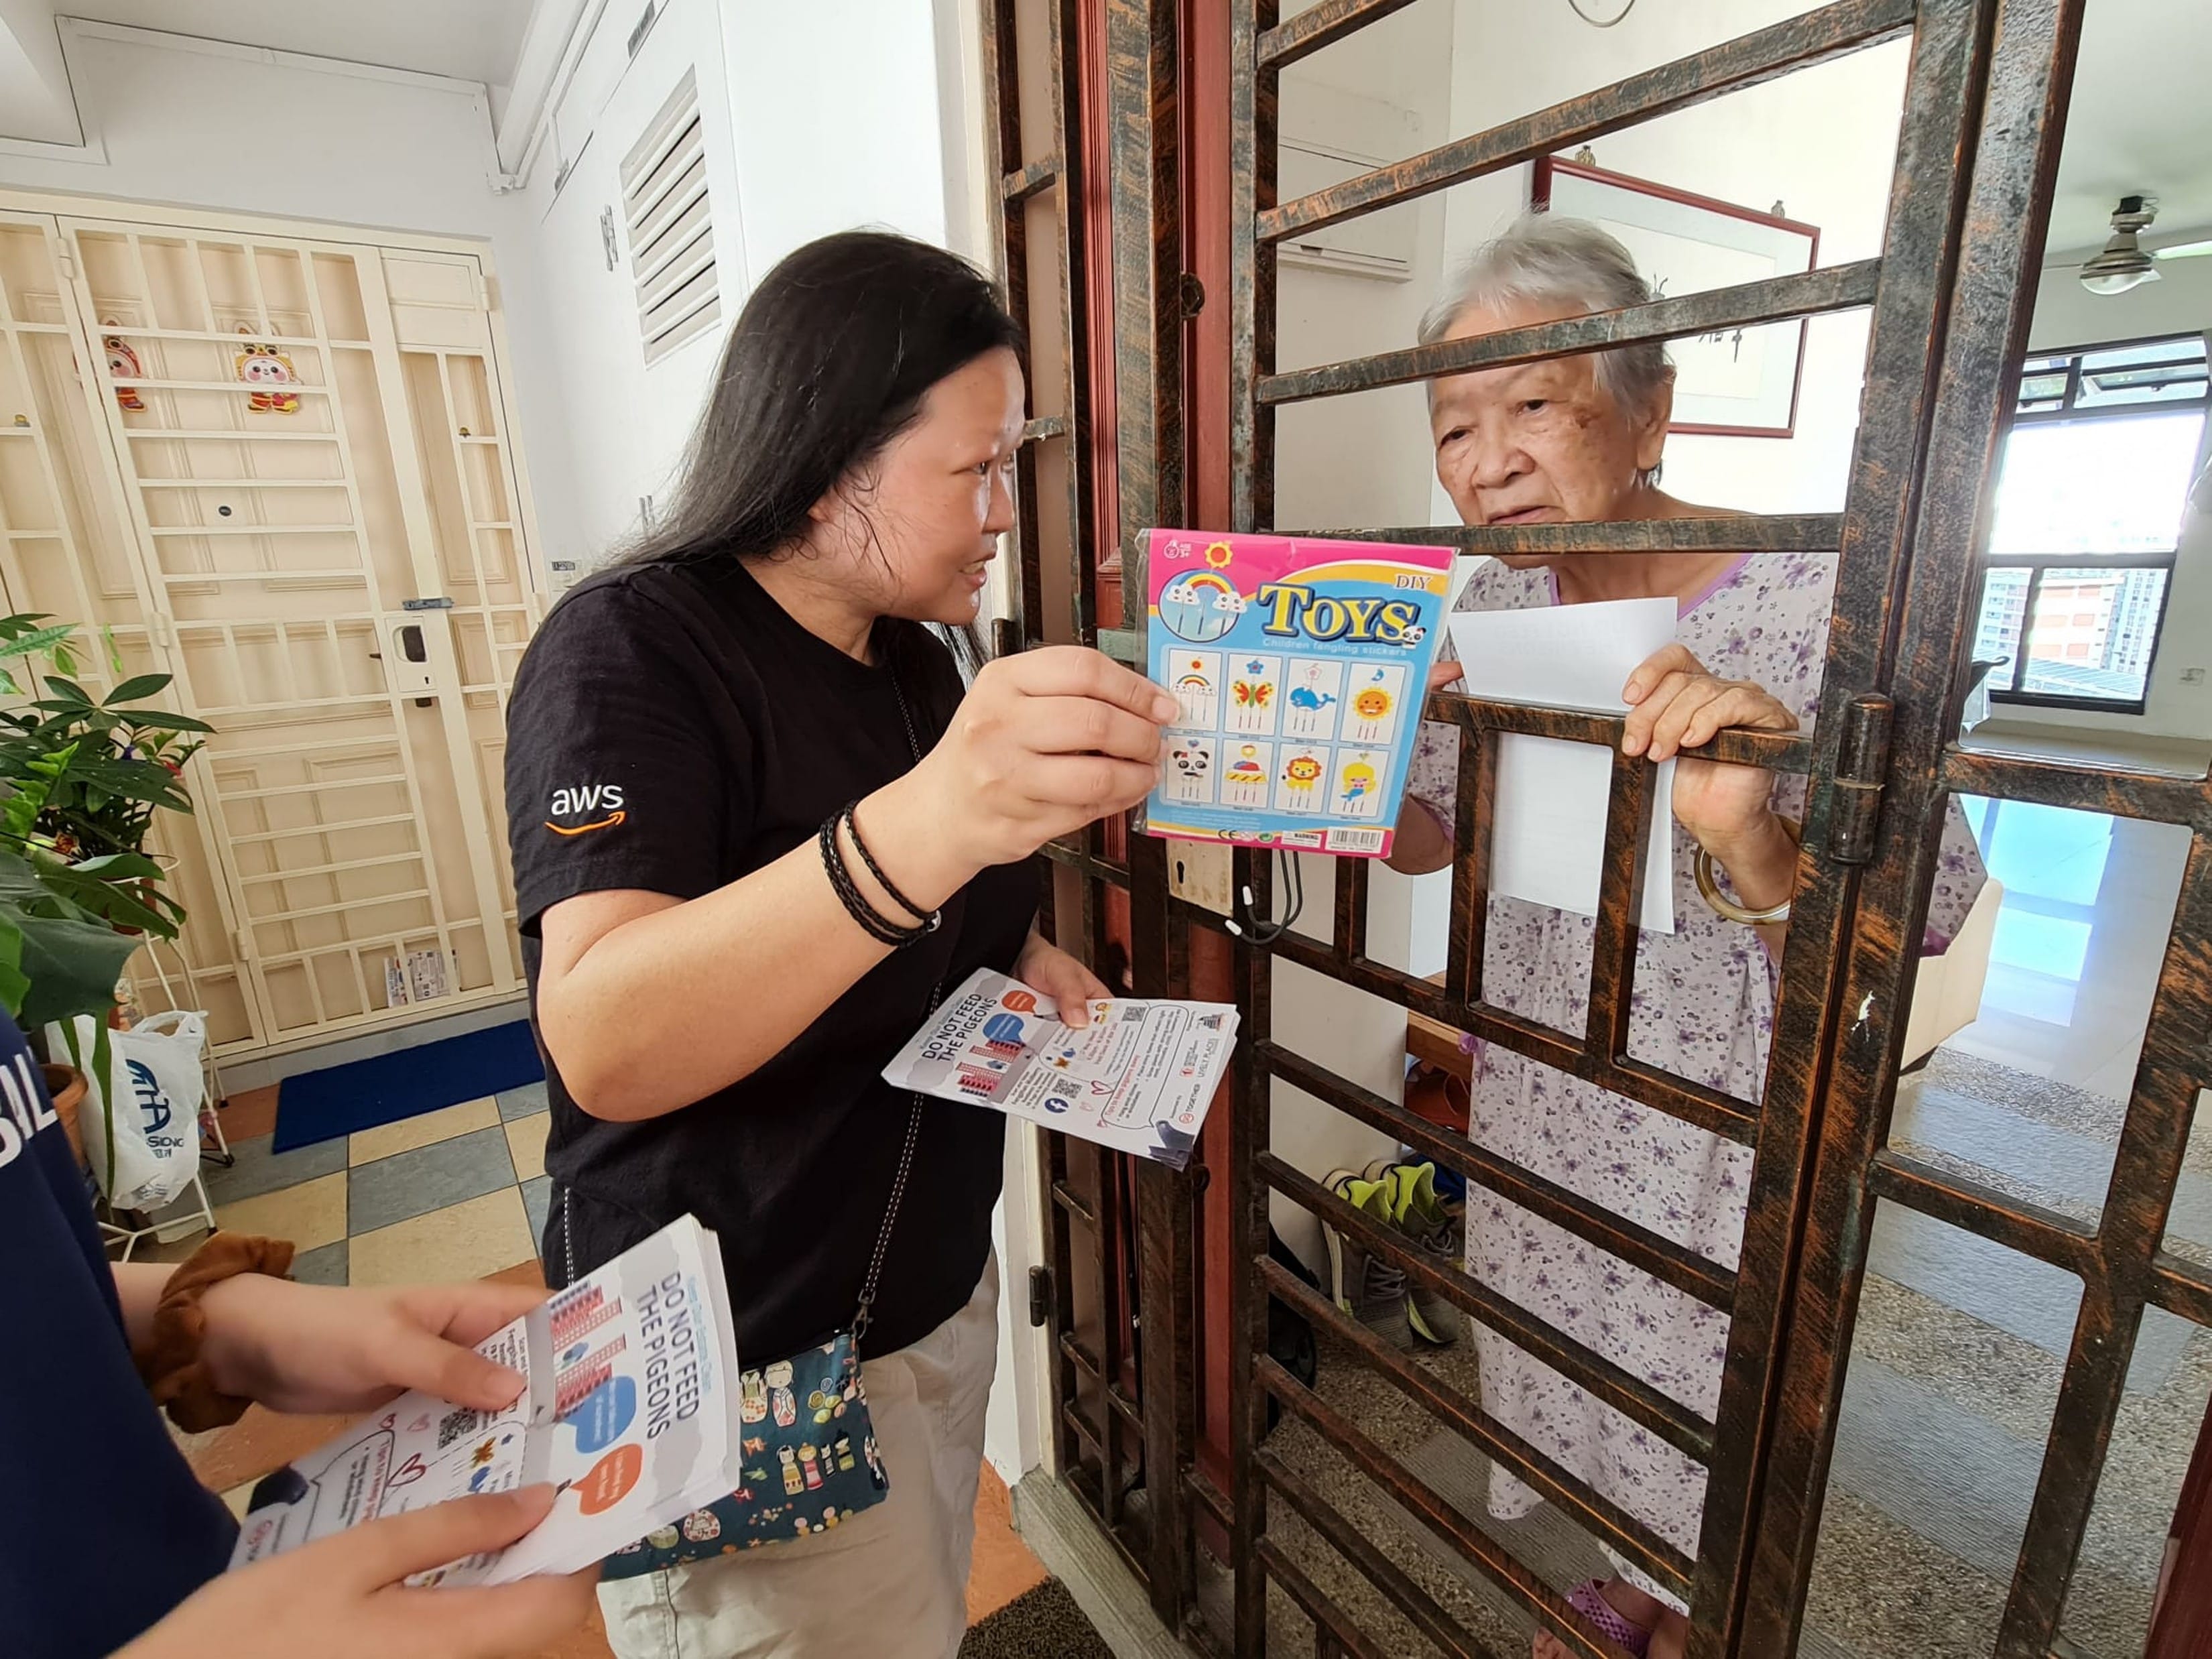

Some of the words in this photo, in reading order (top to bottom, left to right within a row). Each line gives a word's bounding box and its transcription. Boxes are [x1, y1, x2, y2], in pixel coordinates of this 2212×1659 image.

[1396, 574, 1431, 590] DIY
[1256, 582, 1420, 646] TOYS
[1263, 638, 1309, 649] Children
[551, 784, 623, 816] aws
[922, 1042, 942, 1058] DO
[936, 1018, 962, 1040] NOT
[955, 993, 981, 1017] FEED
[937, 1040, 963, 1060] THE
[956, 998, 997, 1039] PIGEONS
[637, 1284, 662, 1337] THE
[662, 1272, 684, 1309] DO
[669, 1308, 694, 1361] NOT
[645, 1335, 670, 1440] PIGEONS
[676, 1363, 699, 1421] FEED
